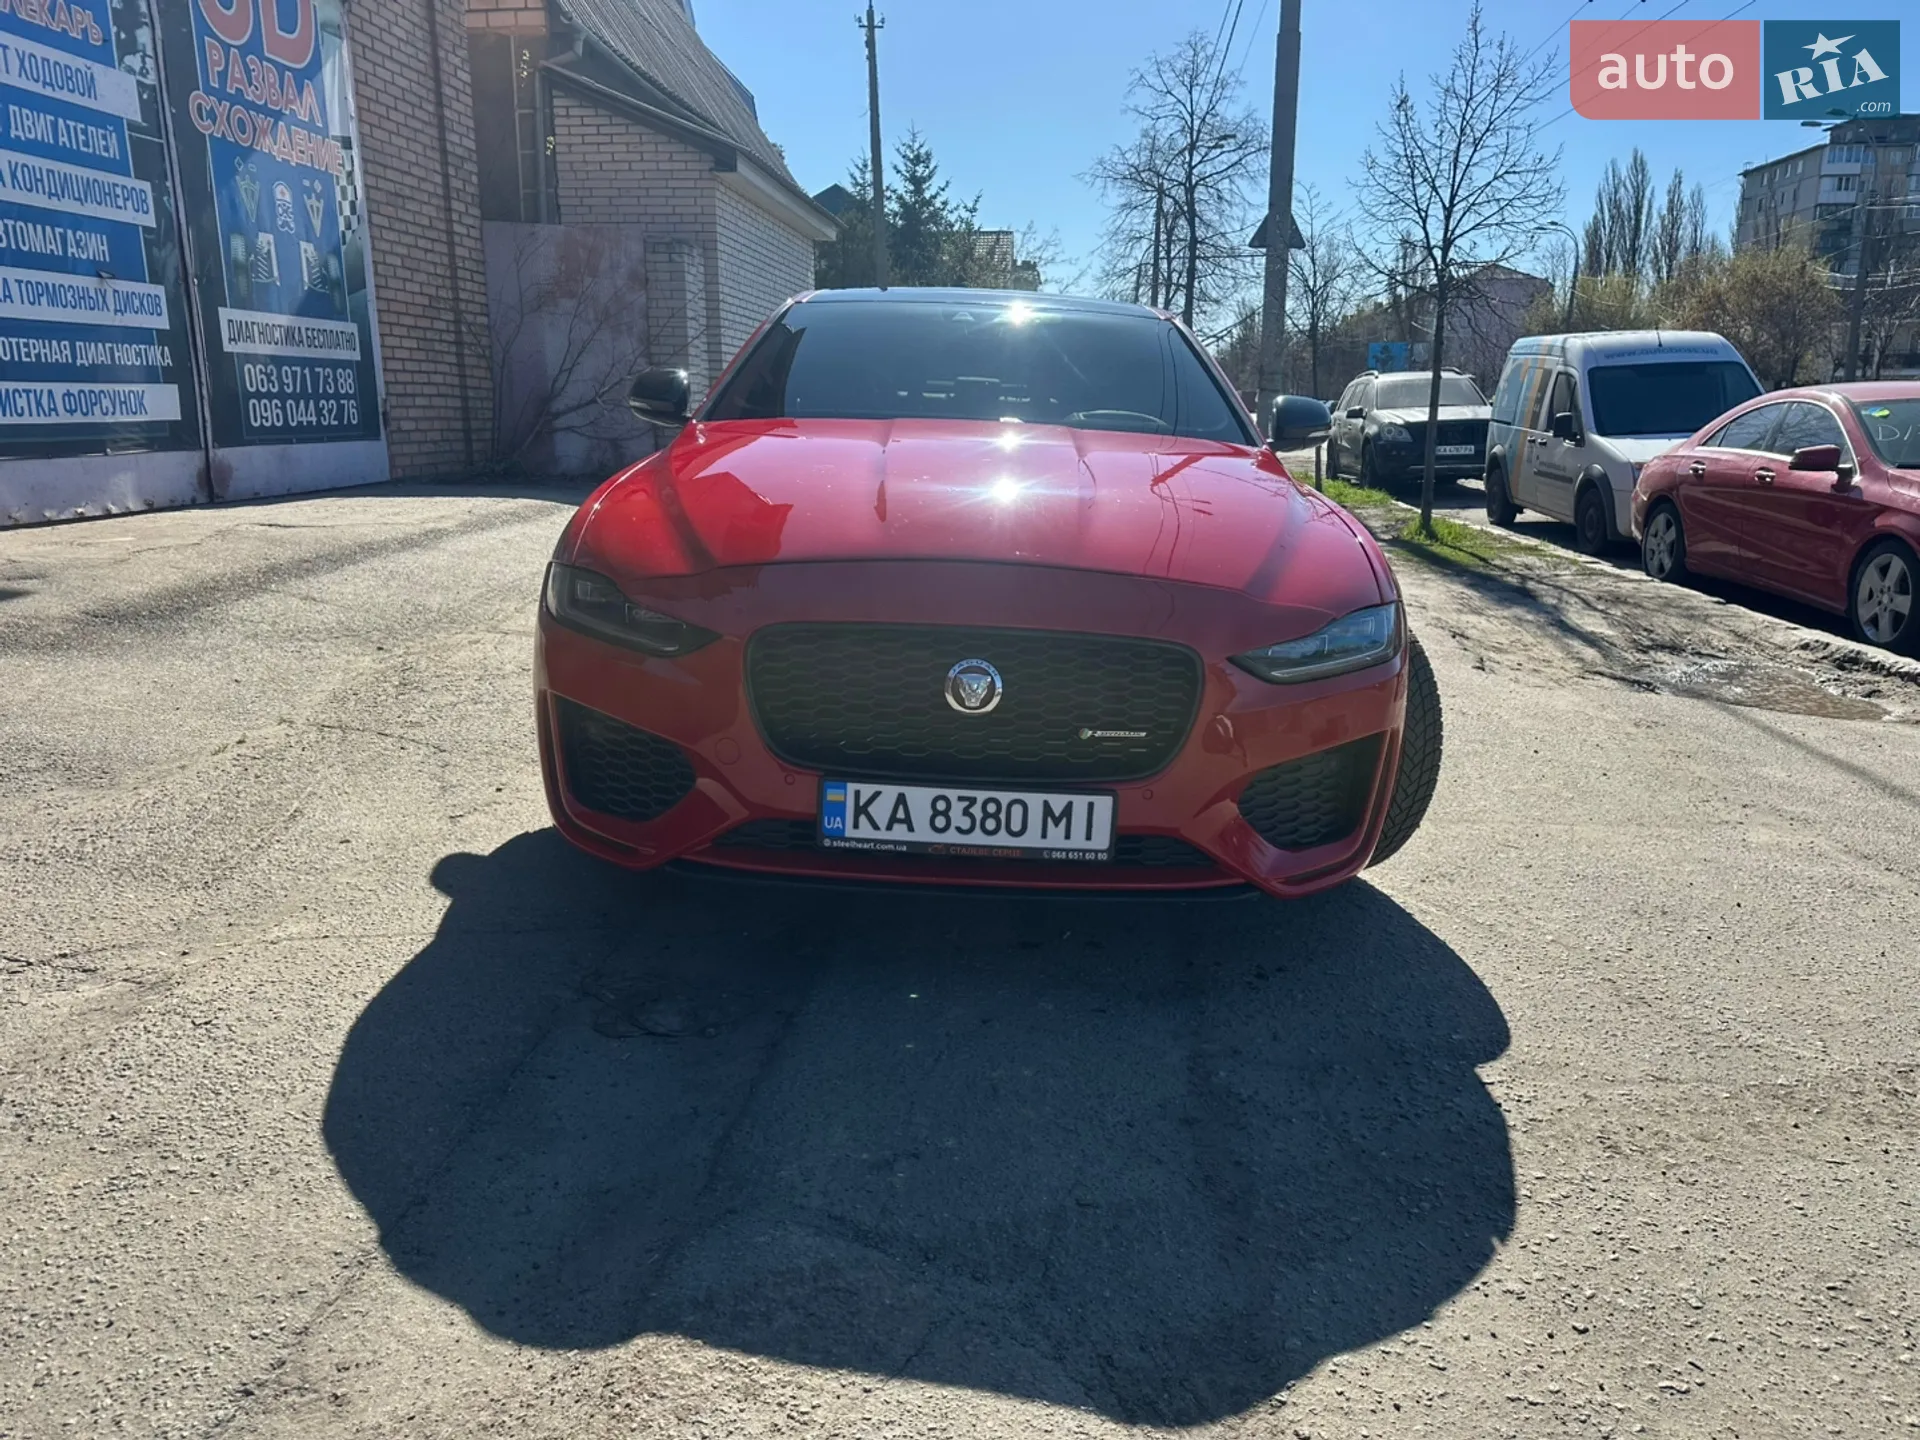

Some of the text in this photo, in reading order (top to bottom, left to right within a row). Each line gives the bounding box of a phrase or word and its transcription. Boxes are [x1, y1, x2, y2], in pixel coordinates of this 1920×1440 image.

[14, 47, 98, 101] ХОДОВОЙ
[204, 36, 323, 127] РАЗВАЛ
[8, 104, 120, 160] ДВИГАТЕЛЕЙ
[189, 91, 344, 177] СХОЖДЕНИЕ
[7, 160, 150, 215] КОНДИЦИОНЕРОВ
[14, 279, 111, 313] ТОРМОЗНЫХ
[112, 289, 163, 317] ДИСКОВ
[76, 341, 173, 367] ДИАГНОСТИКА
[227, 318, 356, 352] ДИАГНОСТИКА БЕСПЛАТНО
[243, 363, 355, 394] 063 971 73 88
[62, 388, 148, 416] ФОРСУНОК
[248, 398, 358, 427] 096 044 32 76
[824, 816, 843, 831] UA
[852, 789, 1095, 841] KA 8380 MI
